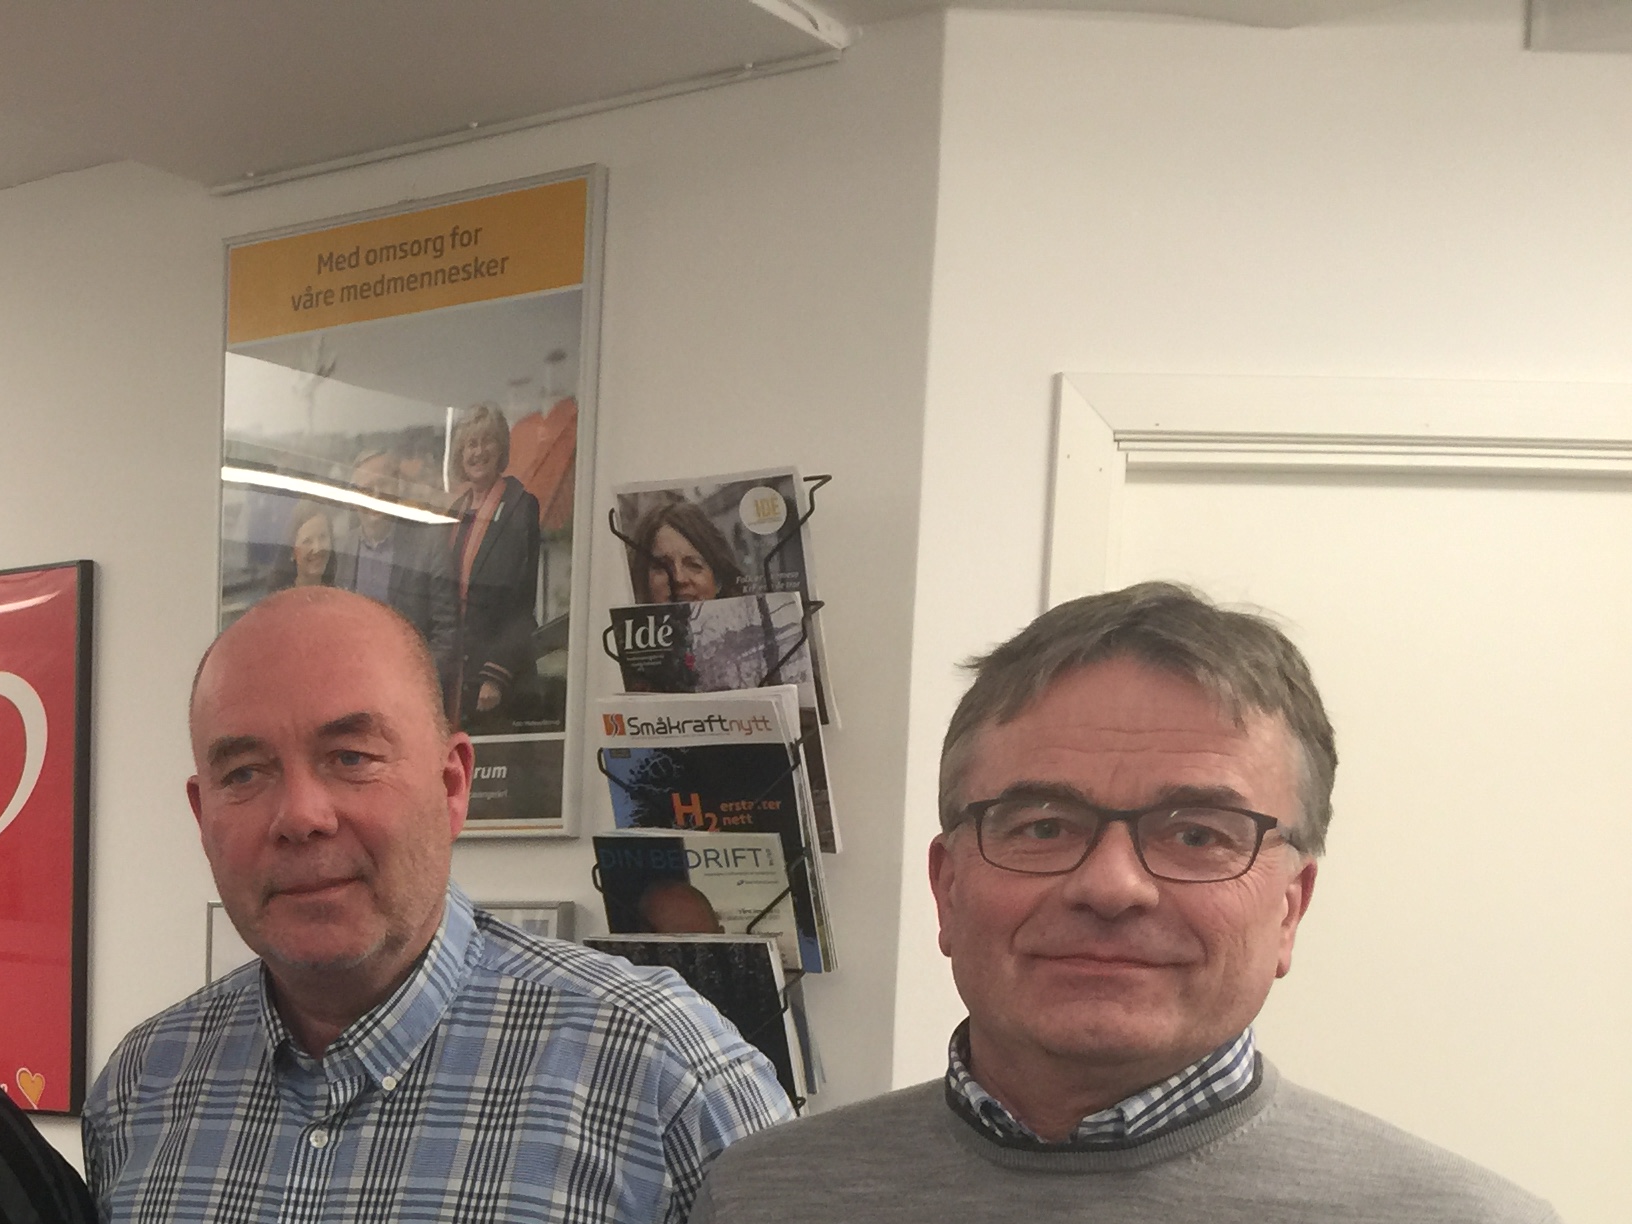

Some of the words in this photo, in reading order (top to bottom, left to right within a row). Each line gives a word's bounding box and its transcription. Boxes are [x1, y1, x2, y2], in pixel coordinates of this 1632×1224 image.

[317, 245, 369, 275] Med
[365, 231, 445, 266] omsorg
[450, 225, 483, 251] for
[291, 285, 335, 312] våre
[339, 254, 510, 302] medmennesker
[624, 614, 674, 651] Idé
[627, 714, 773, 737] Småkraftnytt
[473, 765, 508, 779] rum
[722, 813, 754, 826] nett
[599, 847, 643, 869] DIN
[650, 847, 763, 870] BEDRIFT
